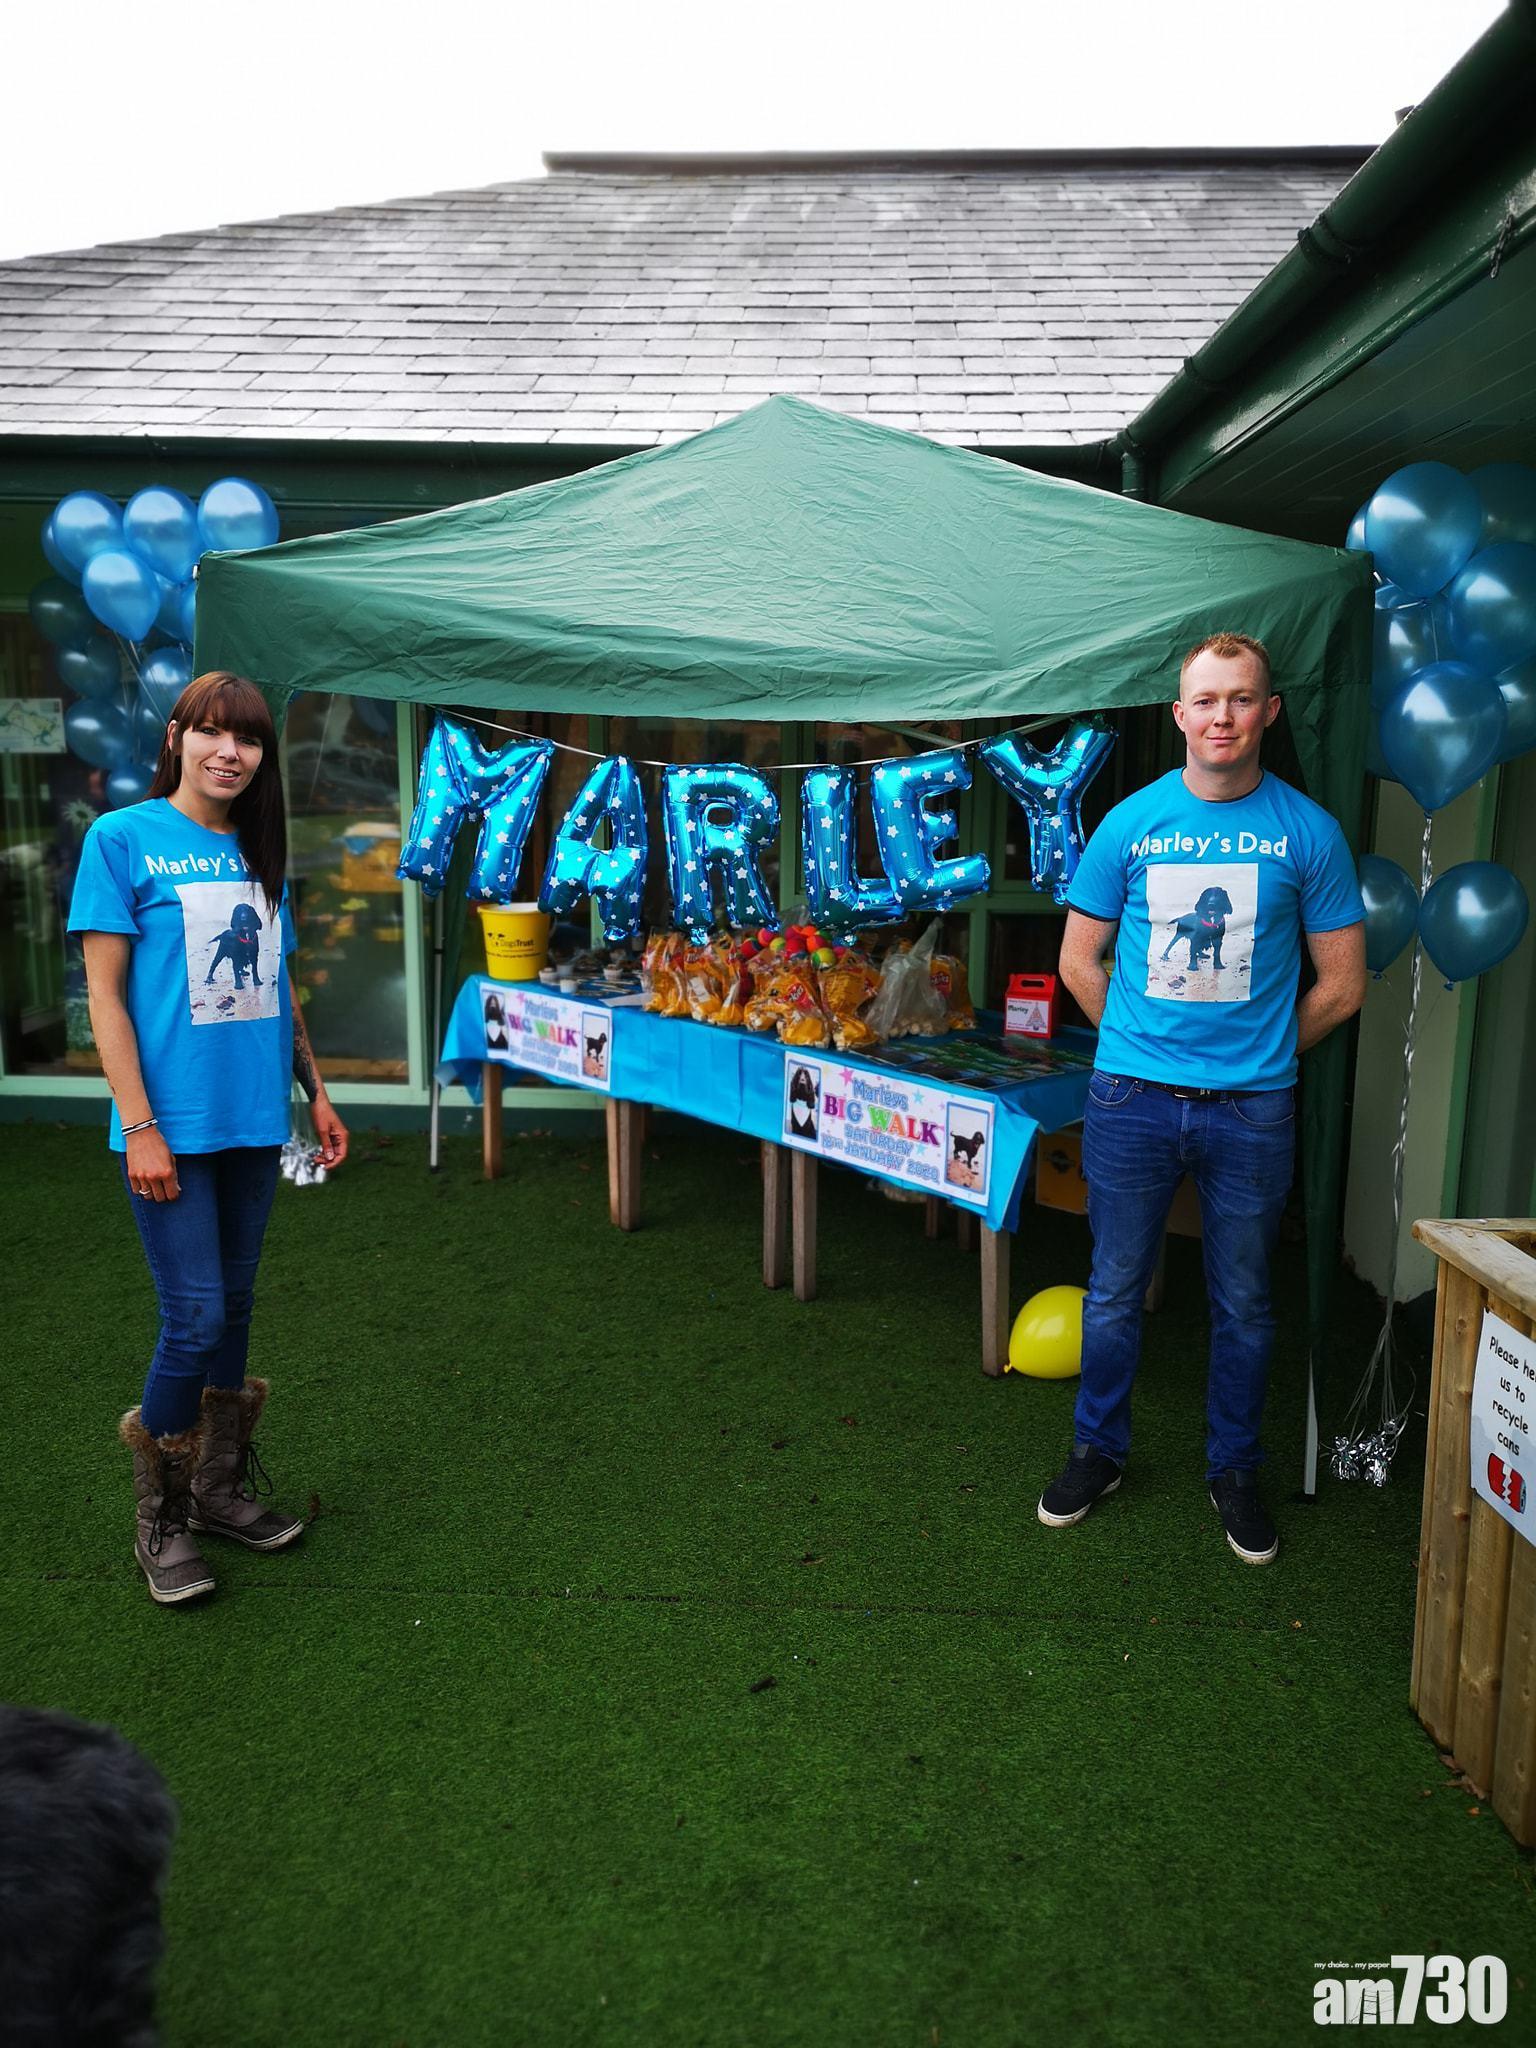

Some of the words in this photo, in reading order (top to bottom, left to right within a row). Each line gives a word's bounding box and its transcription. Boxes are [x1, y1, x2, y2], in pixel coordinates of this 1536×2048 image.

[397, 712, 1120, 944] MARLEY
[1131, 832, 1231, 858] Marley's
[1238, 831, 1288, 858] Dad
[144, 852, 238, 877] Marley's
[534, 1020, 578, 1048] WALK
[853, 1078, 909, 1112] Marleys
[823, 1094, 863, 1123] BIG
[868, 1105, 941, 1146] WALK
[844, 1140, 905, 1170] JANUARY
[845, 1124, 914, 1156] SATURDAY
[1490, 1336, 1519, 1369] Please
[1523, 1359, 1536, 1382] he
[1500, 1377, 1511, 1392] us
[1515, 1385, 1526, 1403] to
[1492, 1400, 1528, 1434] recycle
[1497, 1432, 1519, 1456] cans
